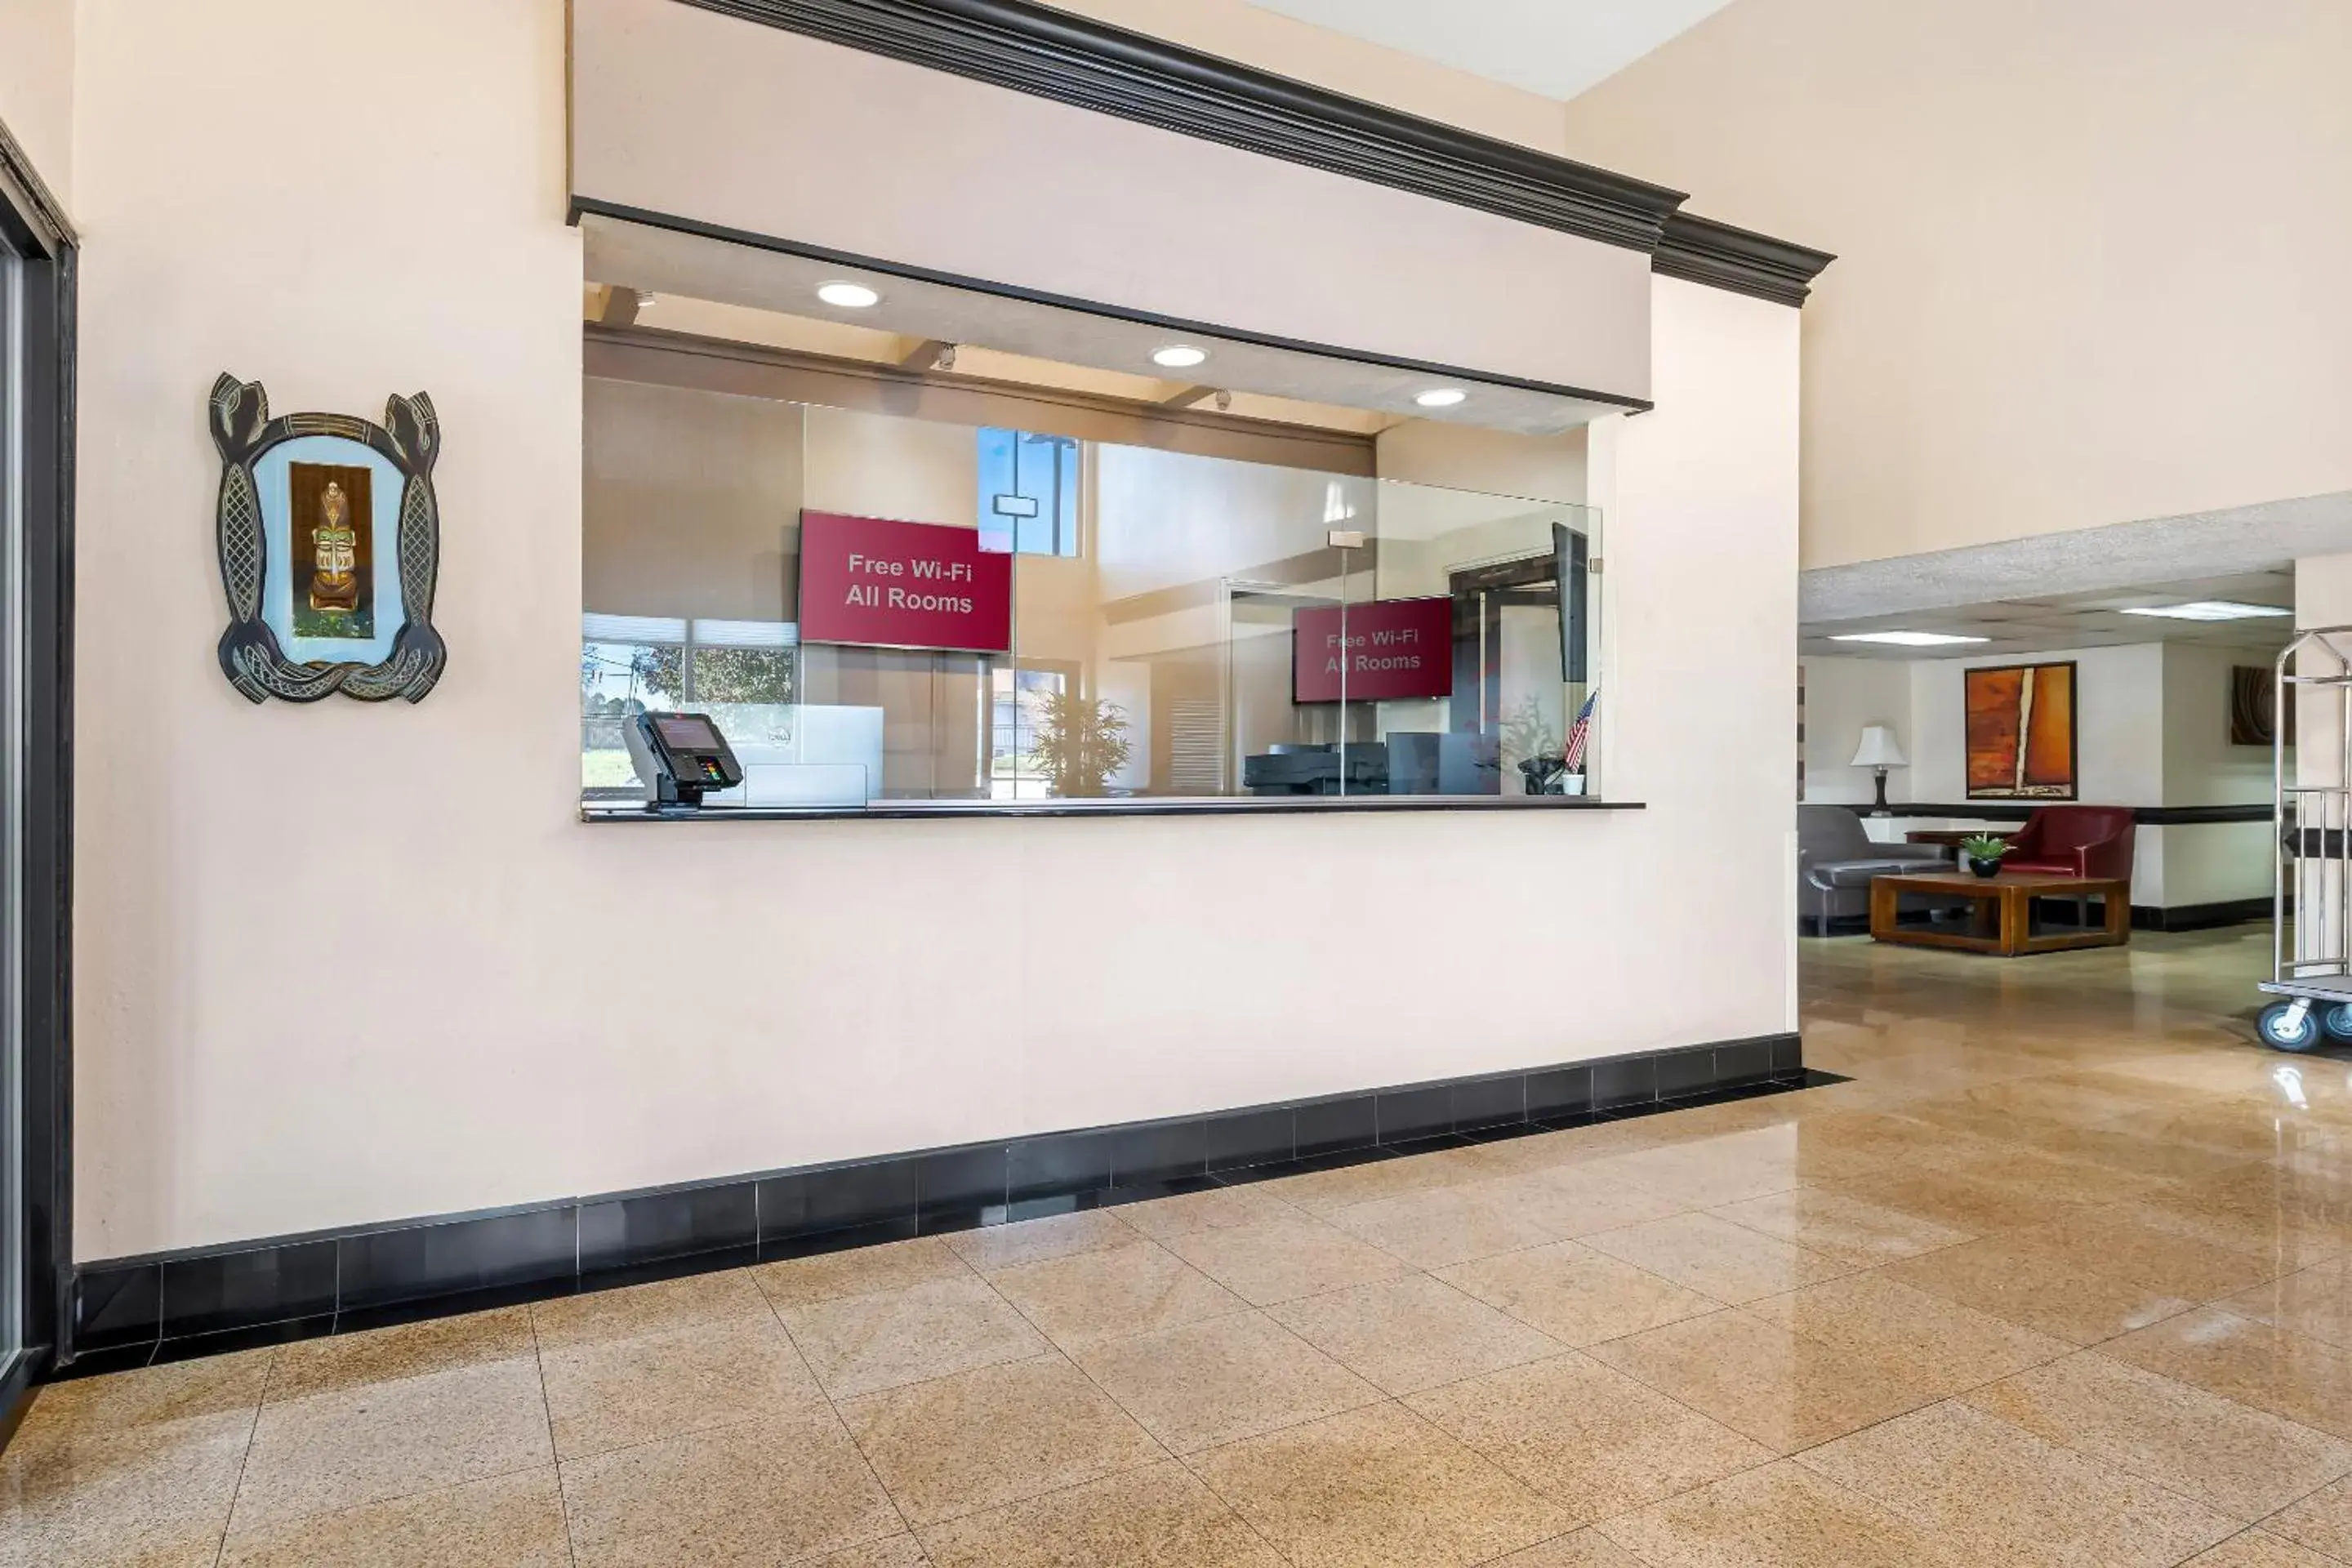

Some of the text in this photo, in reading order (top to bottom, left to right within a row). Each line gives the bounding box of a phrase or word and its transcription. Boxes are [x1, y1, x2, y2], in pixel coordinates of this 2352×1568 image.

[849, 553, 972, 582] Free Wi-Fi
[845, 584, 973, 613] All Rooms
[1372, 628, 1419, 646] Wi-Fi
[1356, 654, 1421, 672] Rooms
